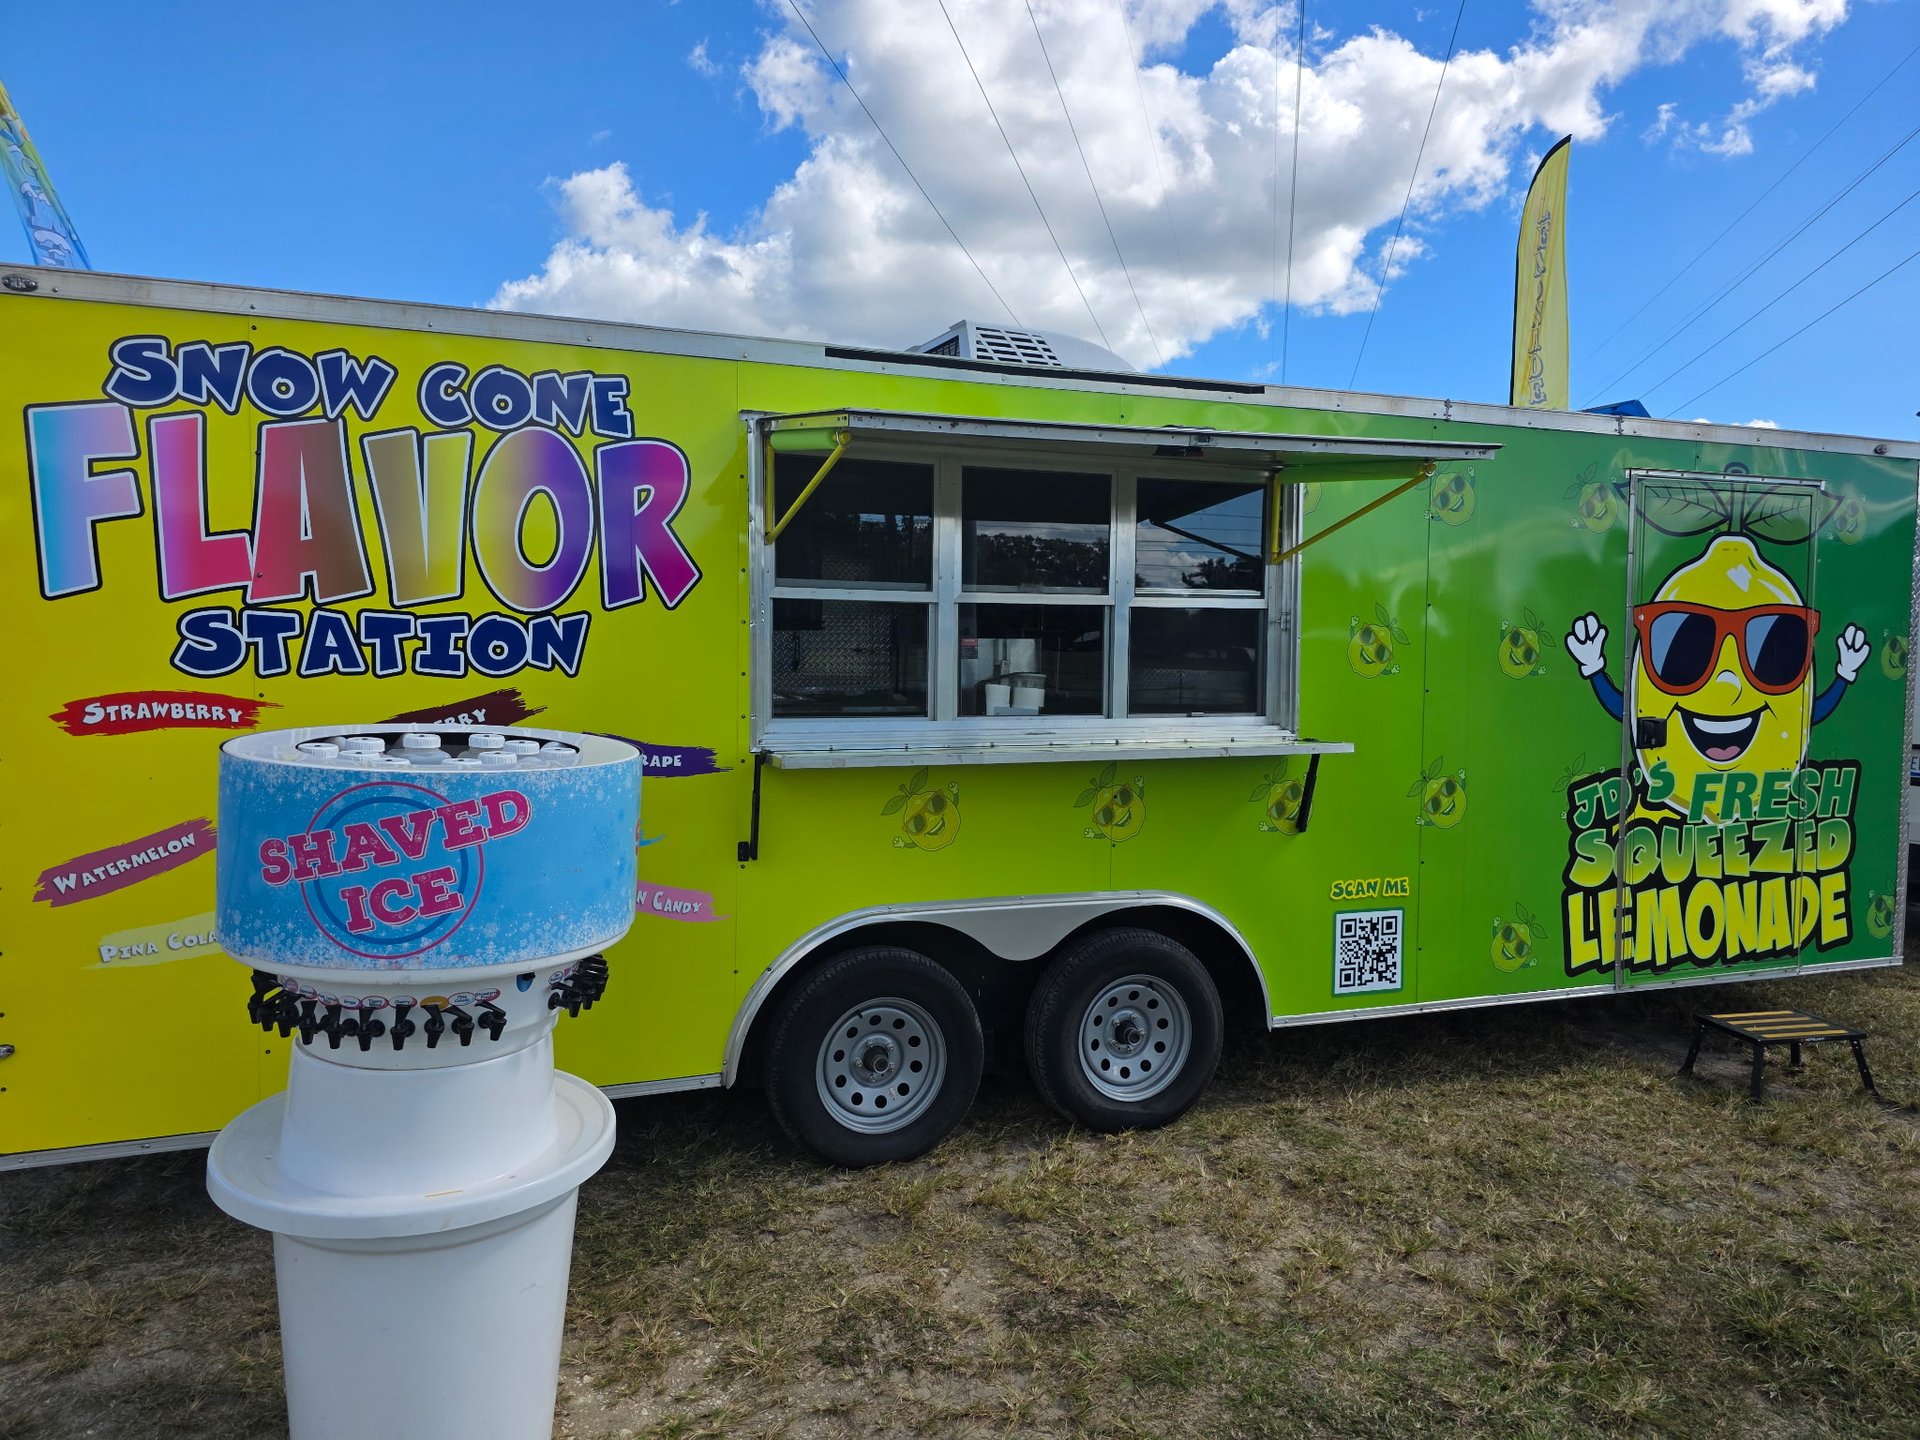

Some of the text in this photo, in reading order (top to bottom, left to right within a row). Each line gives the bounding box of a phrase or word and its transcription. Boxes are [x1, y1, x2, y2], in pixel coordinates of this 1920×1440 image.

[103, 336, 634, 439] SNOW CONE
[25, 400, 703, 612] FLAVOR
[171, 607, 591, 677] STATION
[83, 701, 243, 724] STRAWBERRY
[642, 754, 682, 768] RAPE
[1573, 760, 1857, 829] JD'S FRESH
[52, 832, 196, 895] WATERMELON
[259, 790, 532, 886] SHAVED
[1569, 818, 1852, 887] SQUEEZED
[339, 866, 464, 935] ICE
[1330, 877, 1409, 899] SCAN ME
[1567, 871, 1849, 969] LEMONADE
[98, 941, 160, 963] PINA
